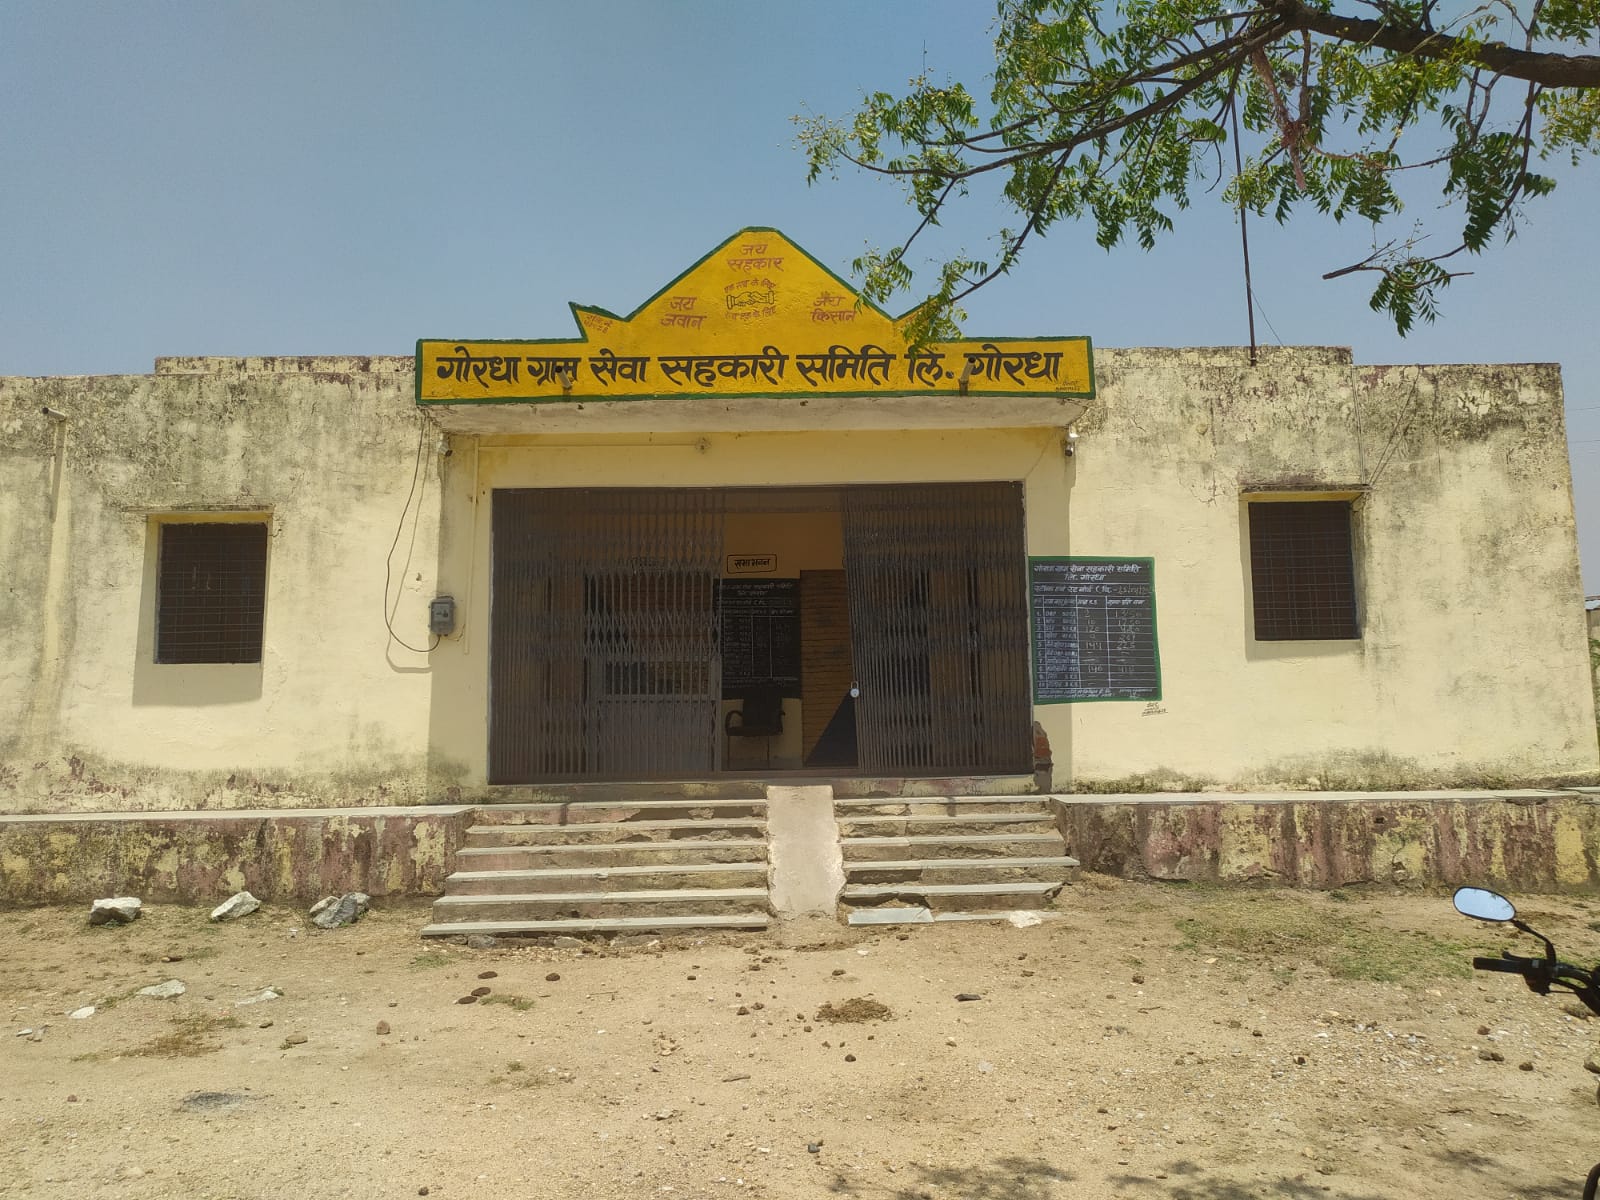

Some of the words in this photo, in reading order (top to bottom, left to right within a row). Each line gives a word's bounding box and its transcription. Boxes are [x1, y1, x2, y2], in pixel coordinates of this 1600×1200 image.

[740, 244, 768, 256] जय
[727, 257, 785, 273] सहकार
[669, 295, 698, 311] जय
[658, 313, 708, 331] जवान
[810, 308, 858, 325] किसान
[436, 345, 521, 389] गोरधा
[527, 355, 582, 386] ग्राम
[589, 347, 651, 387] सेवा
[657, 345, 789, 388] सहकारी
[796, 344, 896, 387] समिति
[904, 344, 955, 387] लि.
[963, 343, 1064, 387] गोरधा
